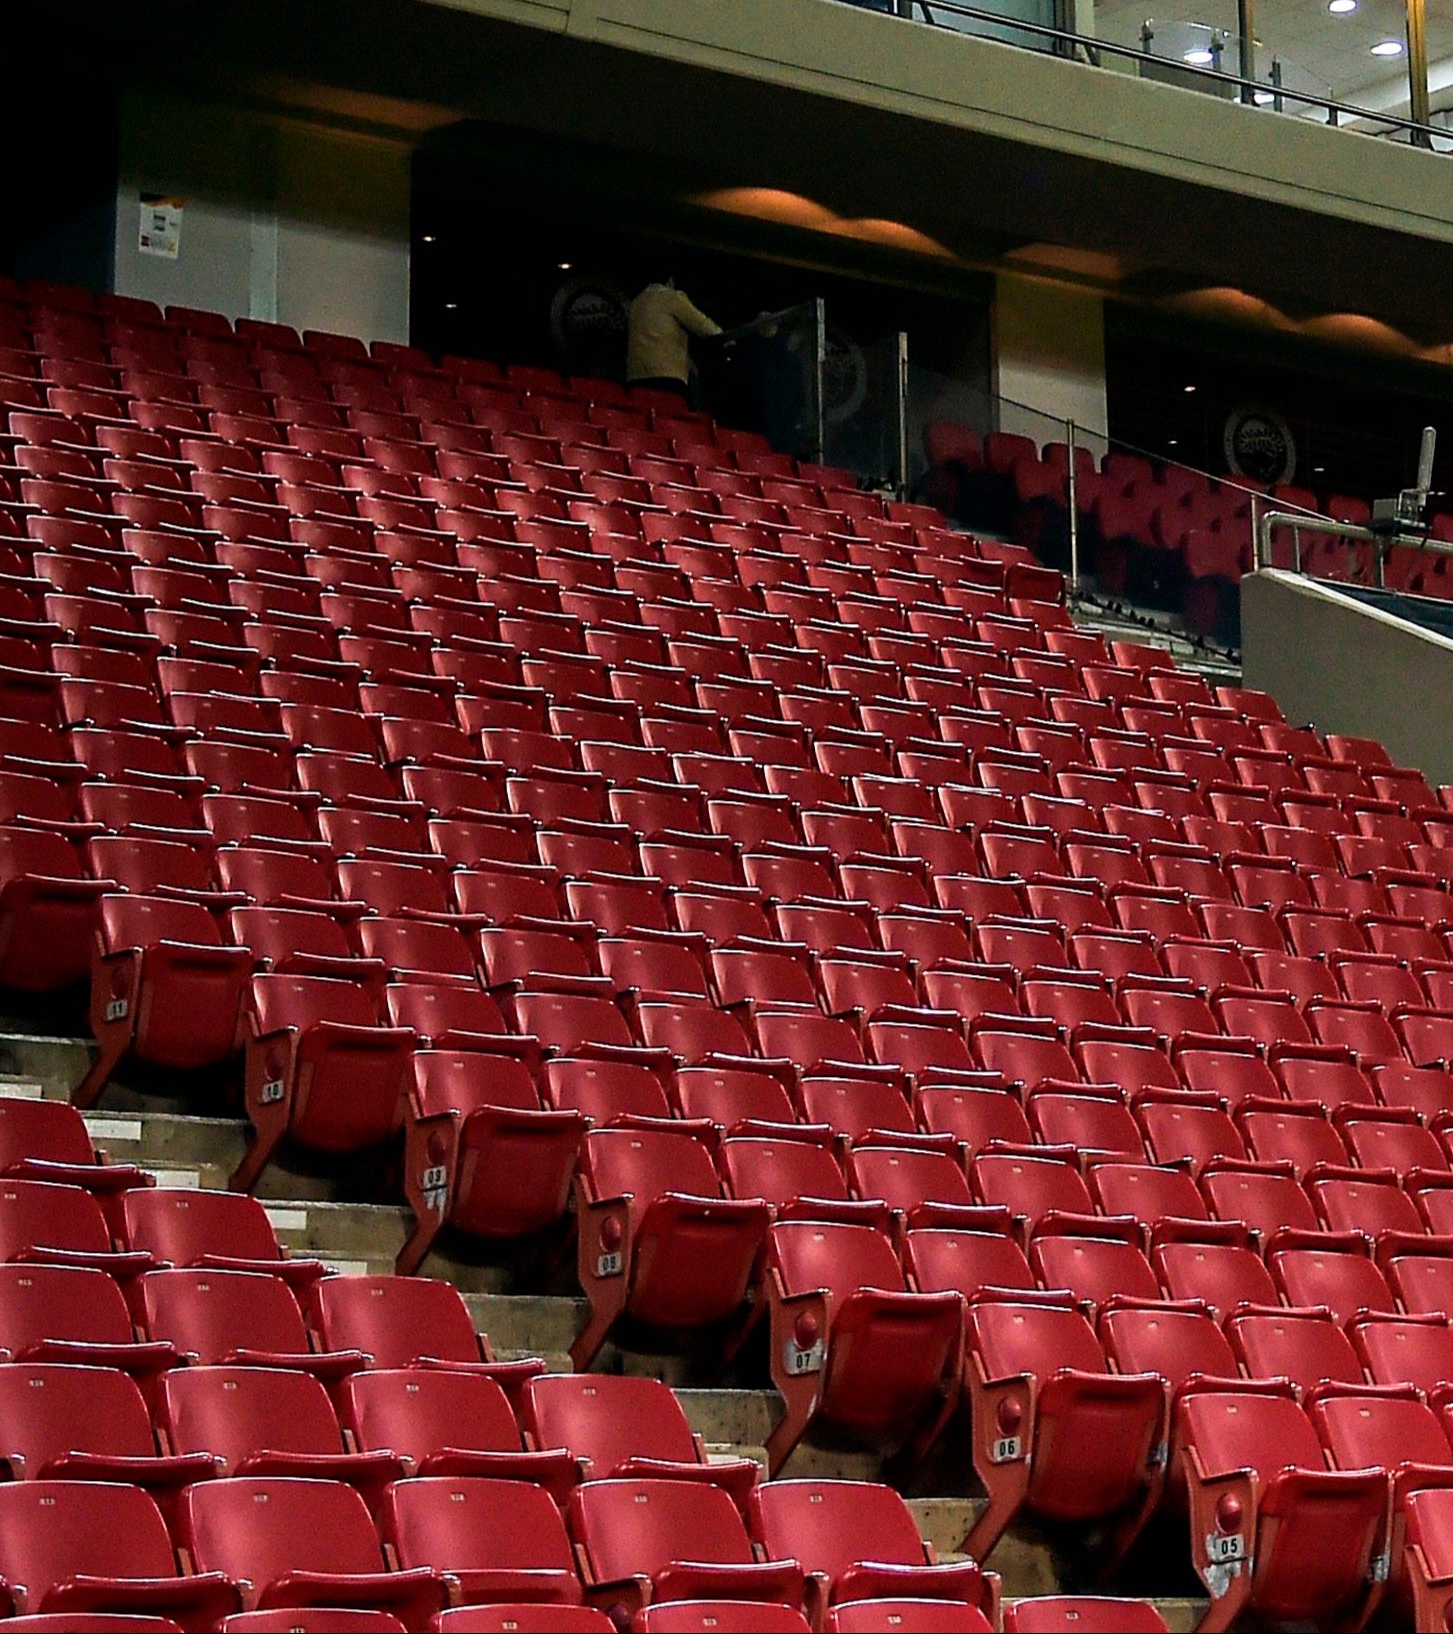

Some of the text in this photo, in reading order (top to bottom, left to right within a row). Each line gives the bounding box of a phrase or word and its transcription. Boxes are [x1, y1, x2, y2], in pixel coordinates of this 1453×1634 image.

[428, 1169, 441, 1184] 09
[796, 1352, 811, 1369] 07
[999, 1439, 1015, 1457] 06
[1221, 1538, 1238, 1555] 05
